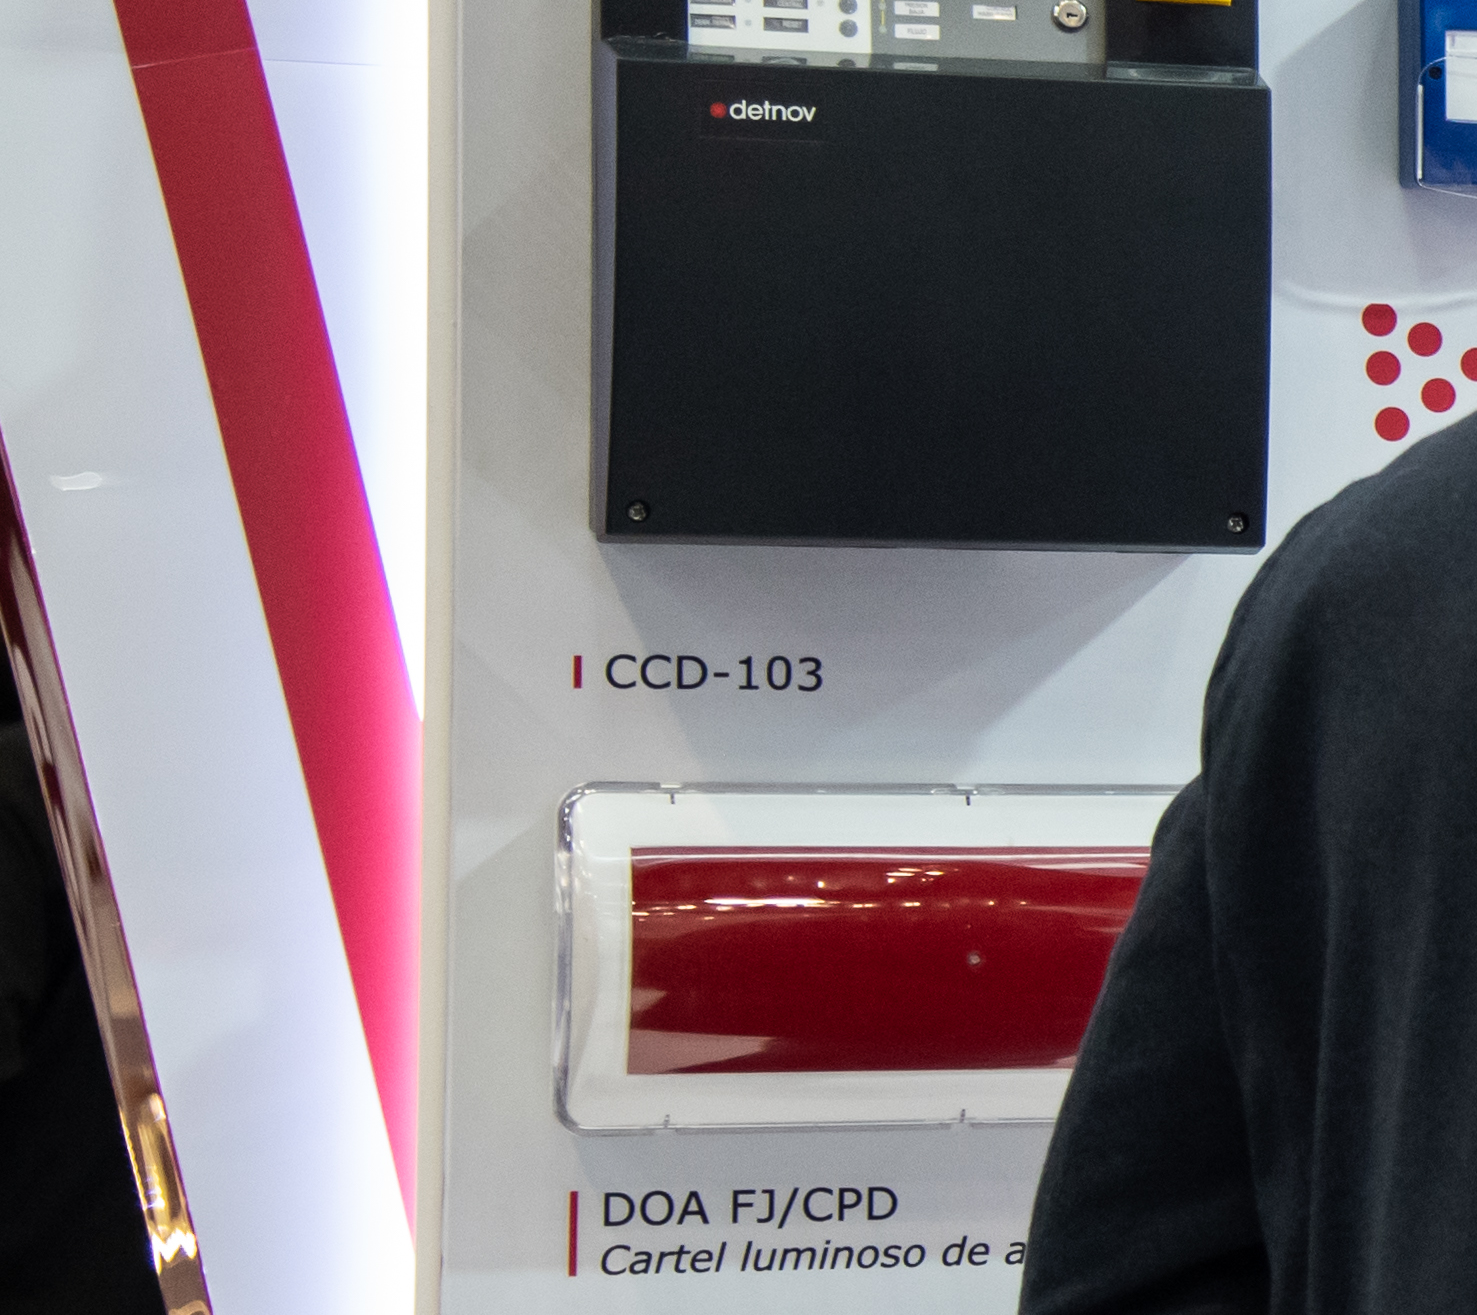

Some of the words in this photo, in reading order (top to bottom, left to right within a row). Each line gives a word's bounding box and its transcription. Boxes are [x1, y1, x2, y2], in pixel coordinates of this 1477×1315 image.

[728, 99, 817, 123] detnov
[605, 653, 824, 693] CCD-103
[603, 1189, 710, 1227] DOA
[731, 1185, 899, 1229] FJ/CPD
[600, 1240, 728, 1276] Cartel
[740, 1239, 927, 1272] luminoso
[941, 1234, 991, 1267] de
